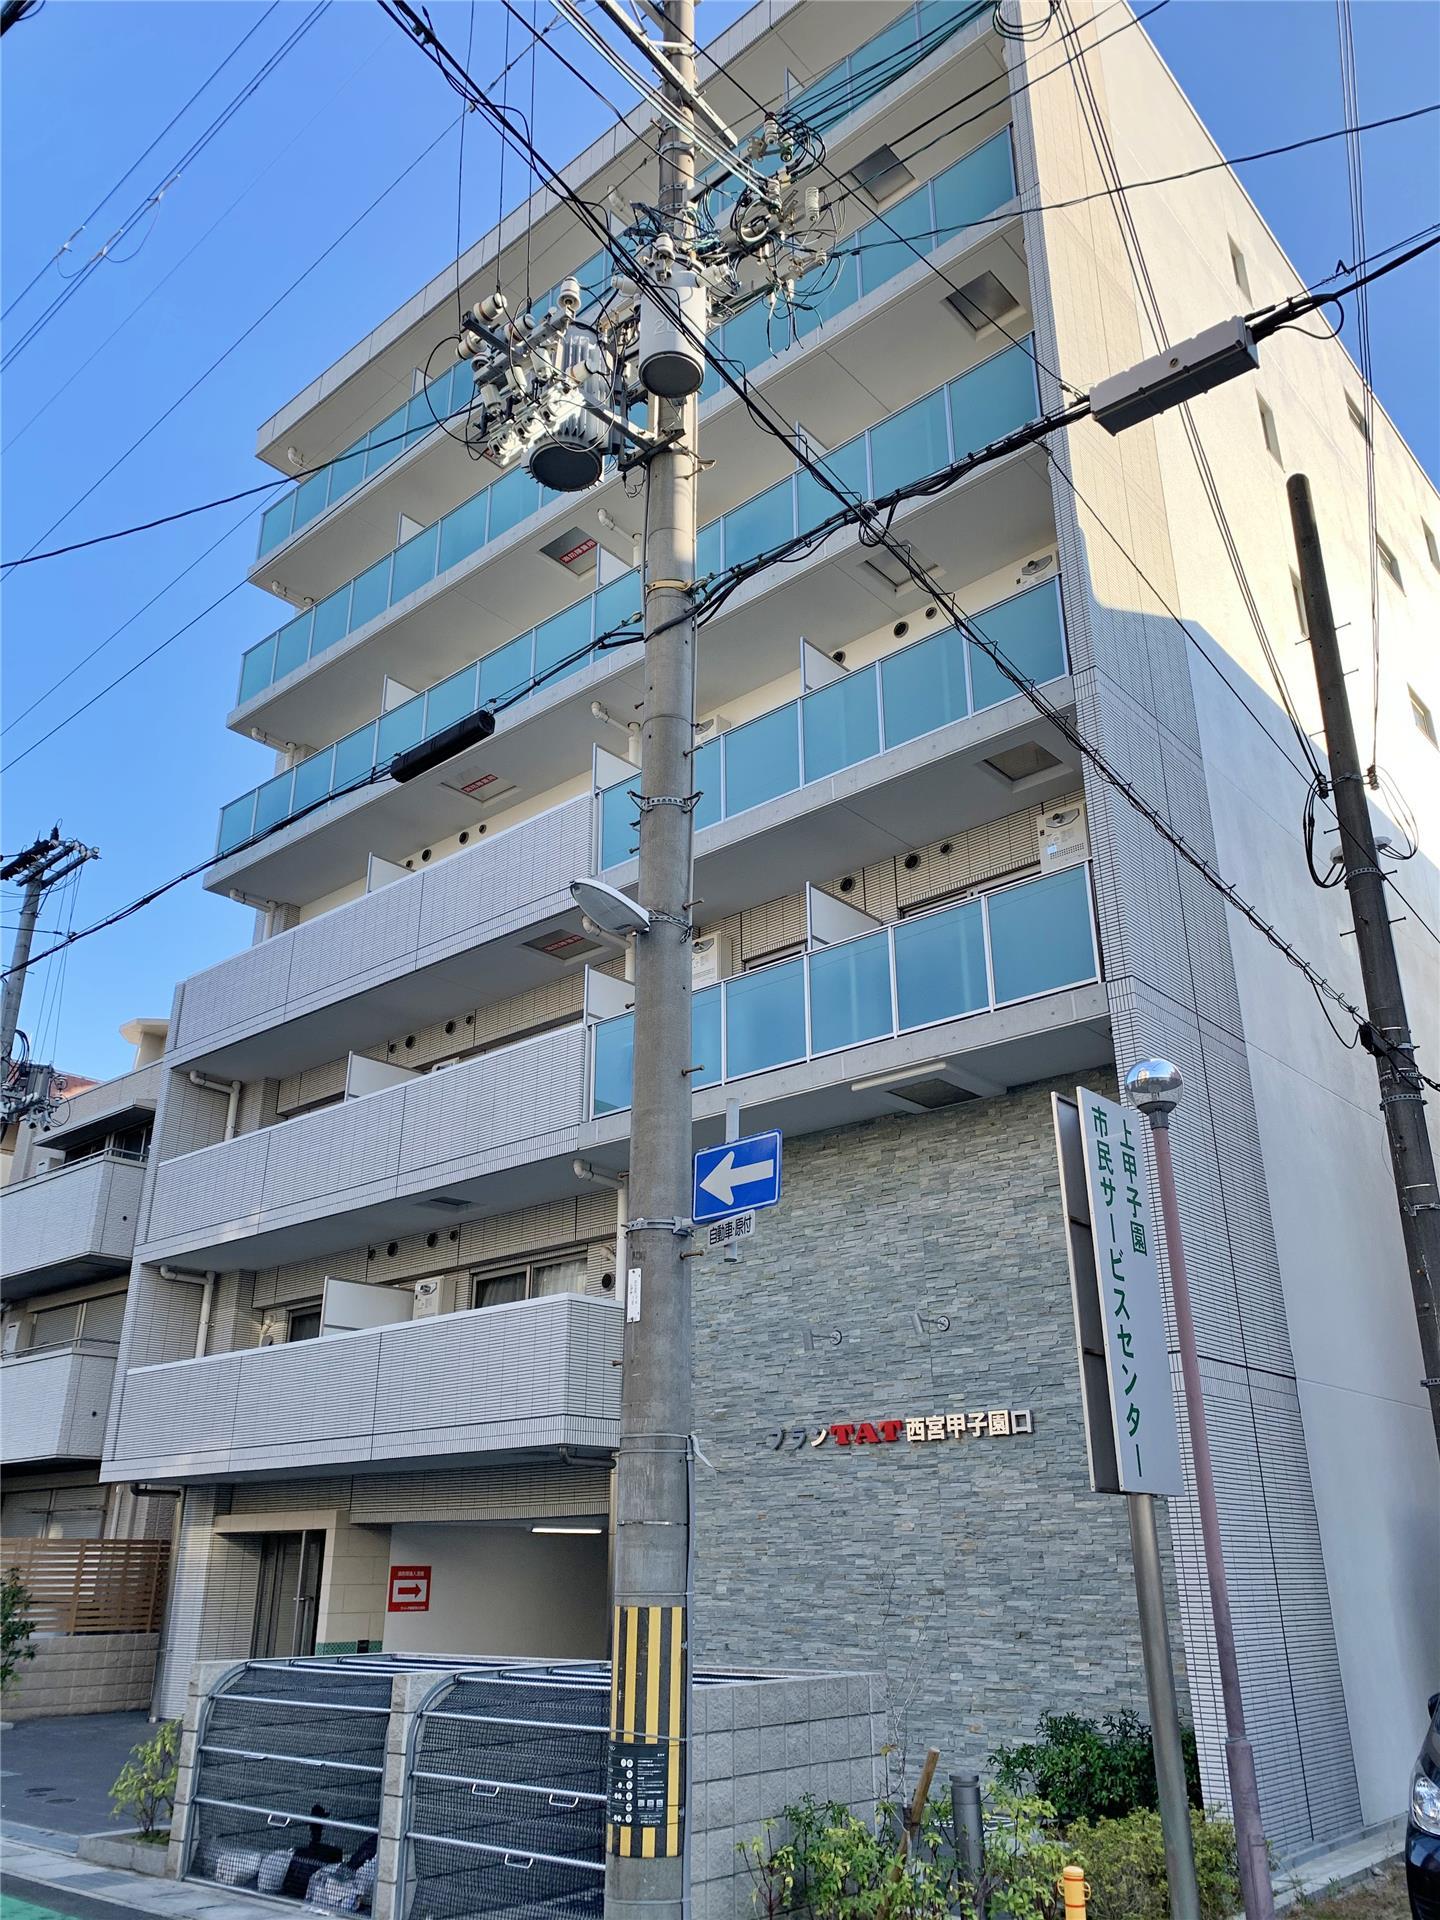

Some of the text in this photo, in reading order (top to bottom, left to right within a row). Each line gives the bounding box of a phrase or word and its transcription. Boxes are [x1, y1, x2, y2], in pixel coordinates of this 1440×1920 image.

[1091, 1105, 1142, 1478] 市民サービスセンター
[1119, 1118, 1148, 1257] 上甲子園
